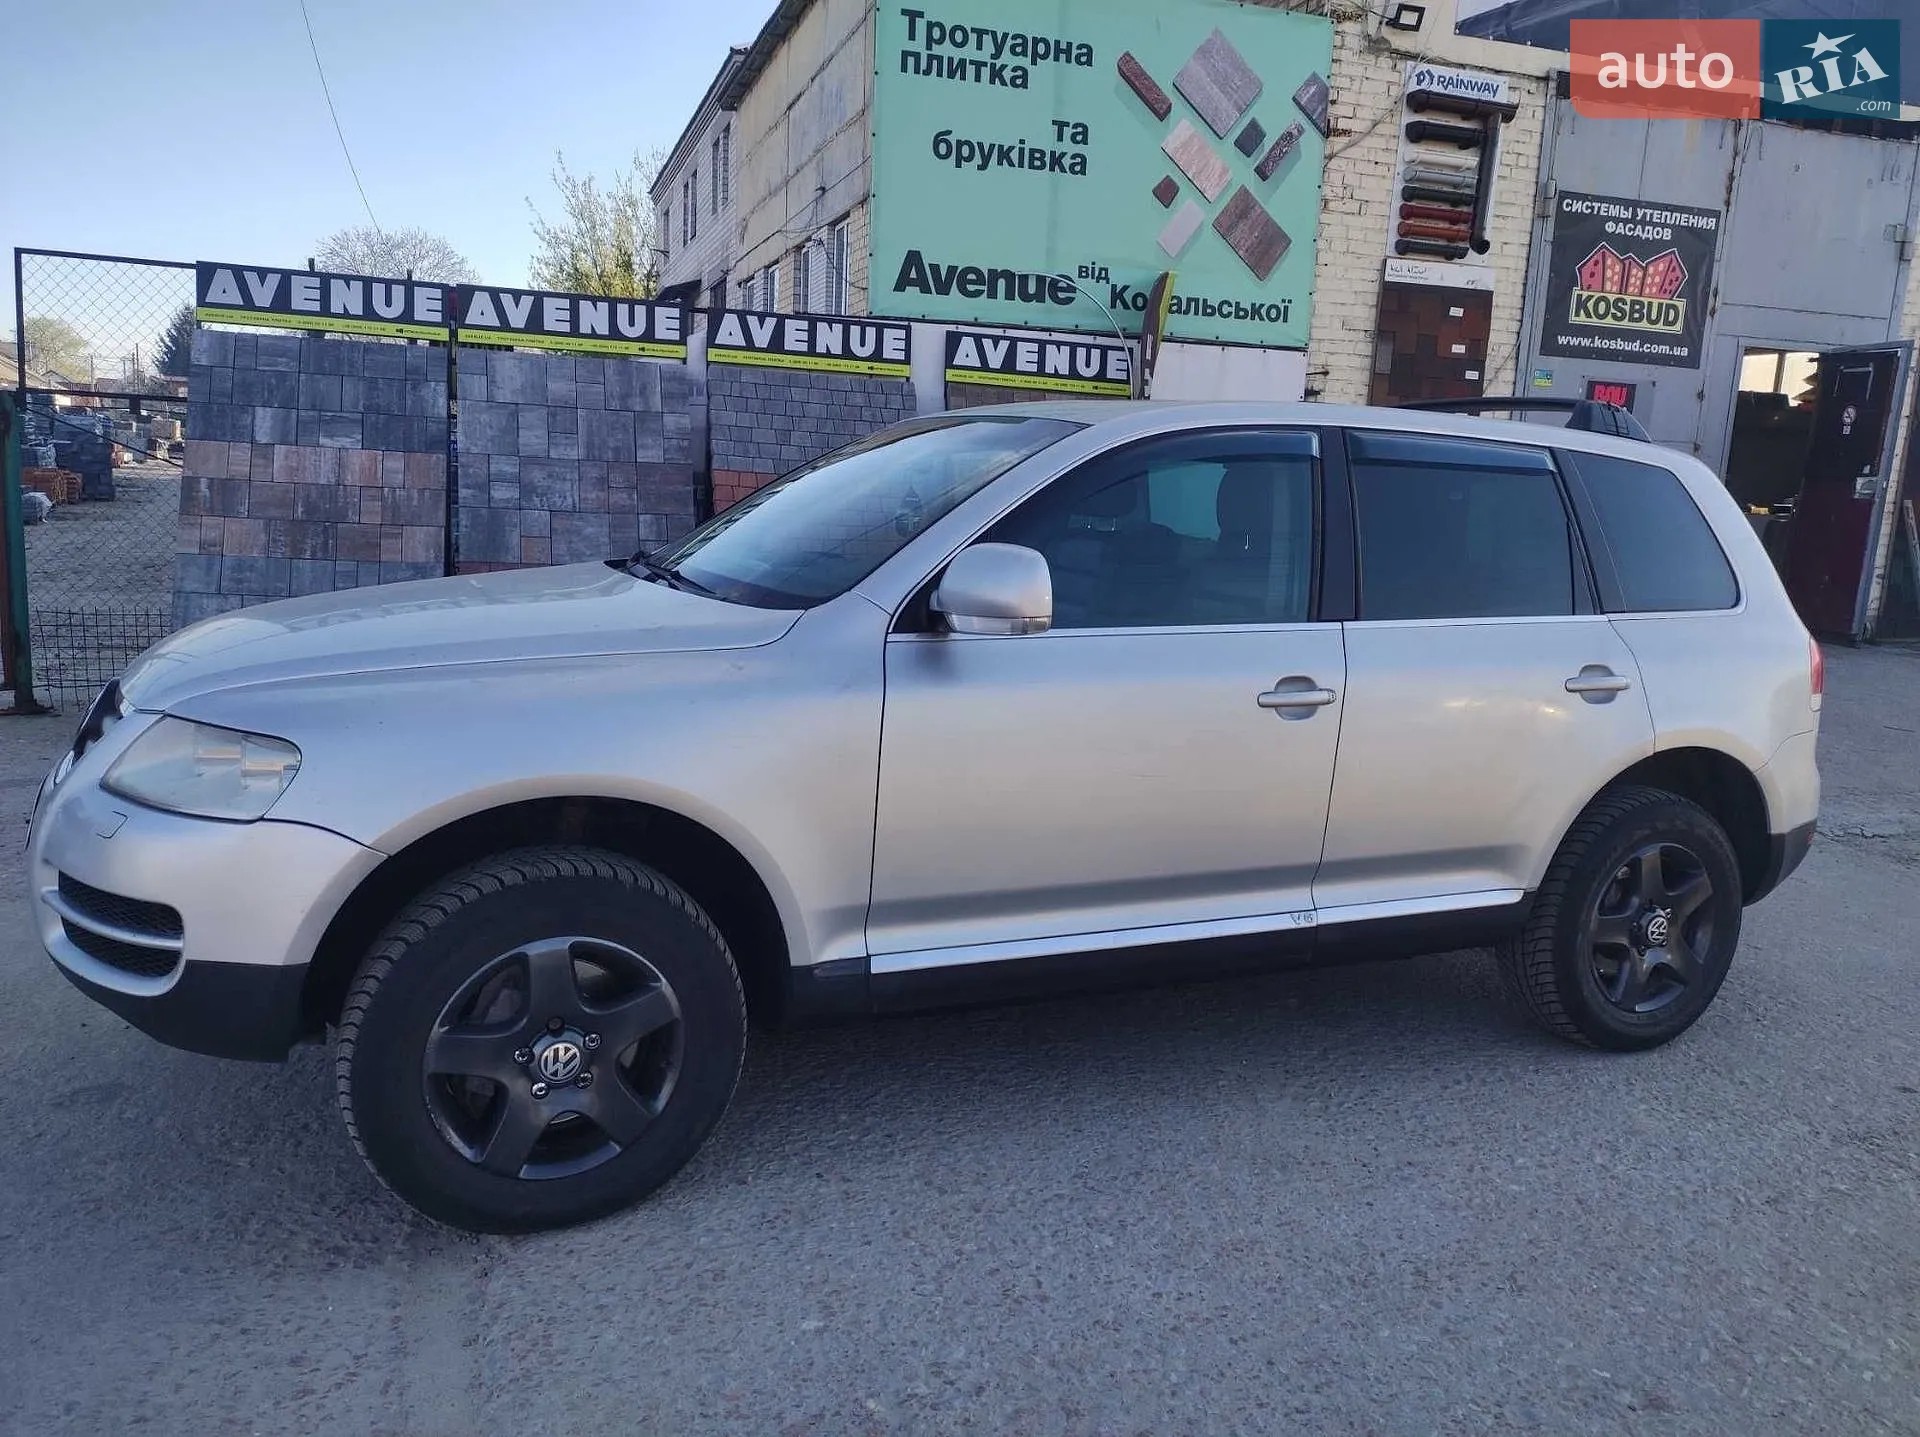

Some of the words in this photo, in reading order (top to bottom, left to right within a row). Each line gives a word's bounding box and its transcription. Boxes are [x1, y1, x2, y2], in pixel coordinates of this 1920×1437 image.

[901, 9, 1094, 67] Тротуарна
[901, 50, 1029, 90] плитка
[1051, 119, 1090, 146] та
[932, 130, 1088, 176] бруківка
[1562, 199, 1632, 220] СИСТЕМЫ
[1636, 208, 1717, 230] УТЕПЛЕНИЯ
[1605, 221, 1672, 240] ФАСАДОВ
[893, 250, 1077, 306] Avenue
[1078, 261, 1110, 284] від
[205, 268, 443, 323] AVENUE
[1110, 283, 1292, 323] Коальської
[1573, 293, 1680, 327] KOSBUD
[465, 291, 680, 341] AVENUE
[714, 313, 906, 360] AVENUE
[1557, 334, 1689, 357] www.kosbud.com.ua
[952, 336, 1129, 380] AVENUE
